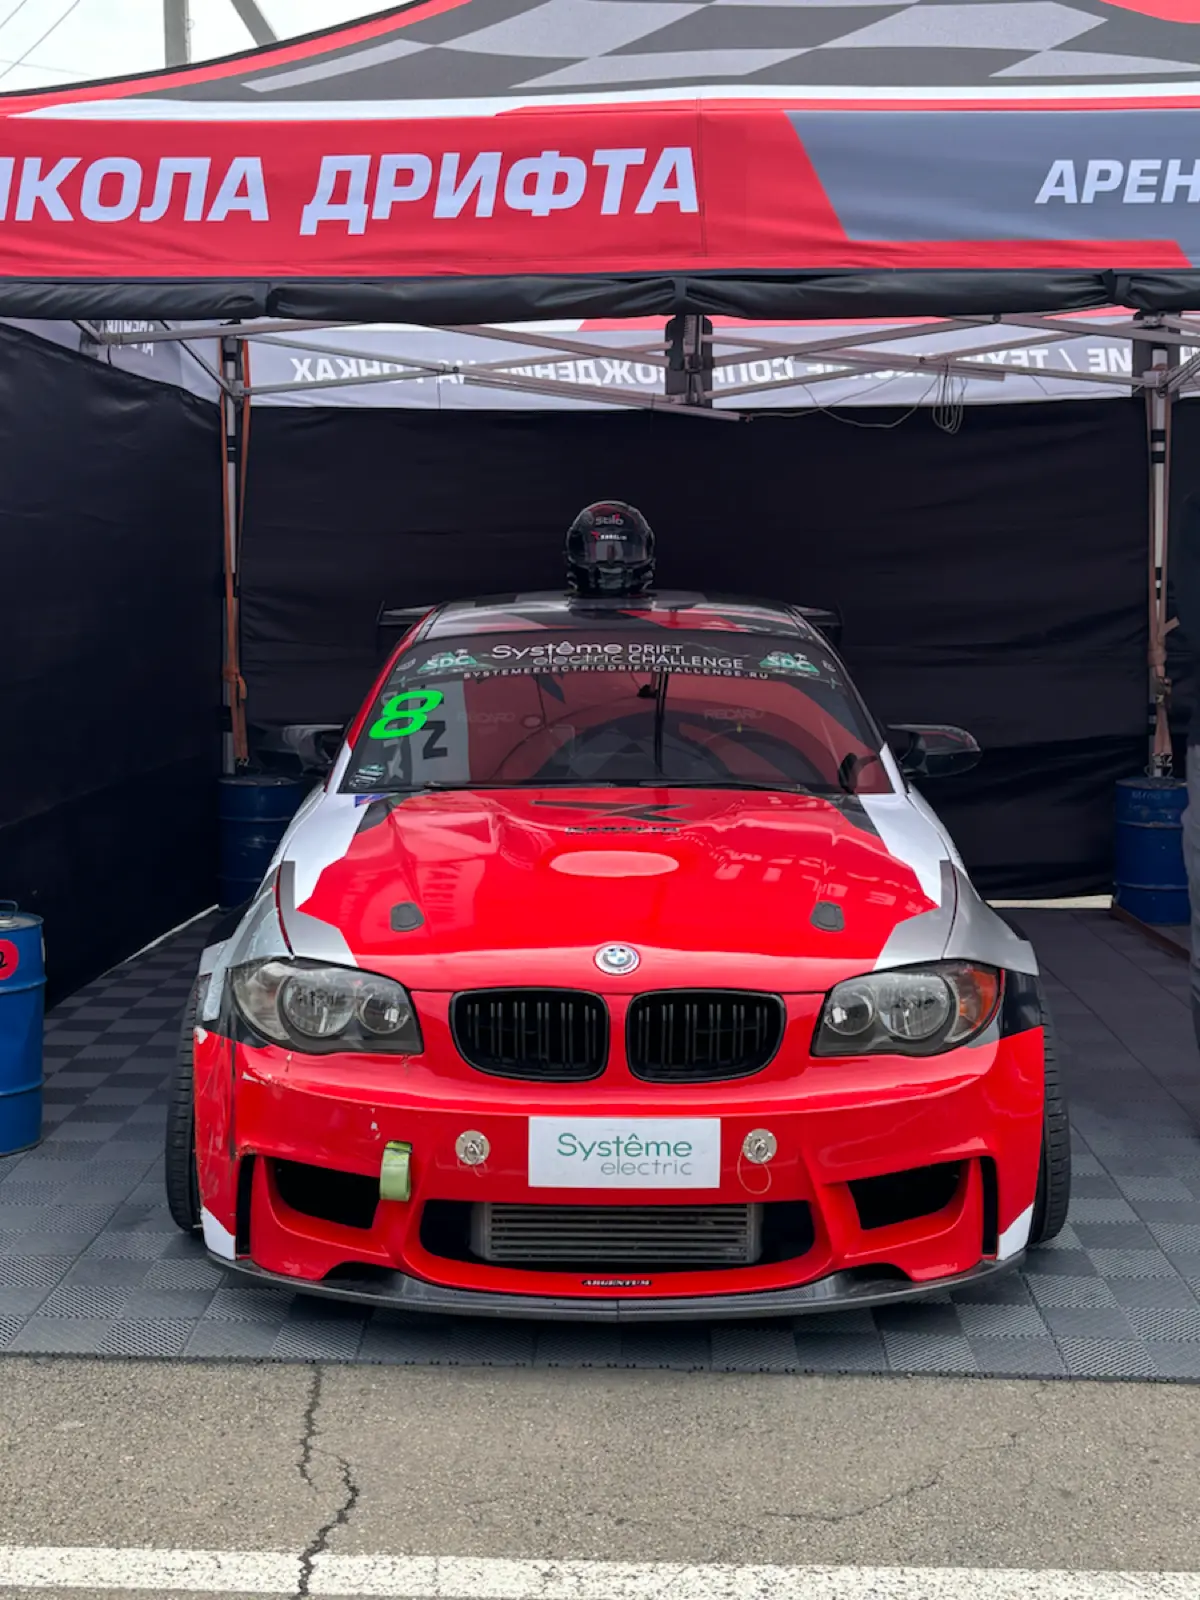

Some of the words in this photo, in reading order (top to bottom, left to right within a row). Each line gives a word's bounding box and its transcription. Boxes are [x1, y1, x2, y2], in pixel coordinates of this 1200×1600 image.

[1035, 158, 1200, 204] АРЕН
[0, 156, 270, 222] КОЛА
[299, 147, 700, 235] ДРИФТА
[491, 640, 623, 661] Système
[628, 643, 683, 655] DRIFT
[426, 655, 470, 669] SDC
[532, 652, 623, 666] electric
[628, 653, 744, 669] CHALLENGE
[767, 657, 812, 672] SDC
[463, 663, 769, 680] SYSTEMEELECTRICDRIFTCHALLENGE.RU
[369, 689, 444, 739] 8
[556, 1132, 693, 1162] Système
[600, 1159, 693, 1176] electric
